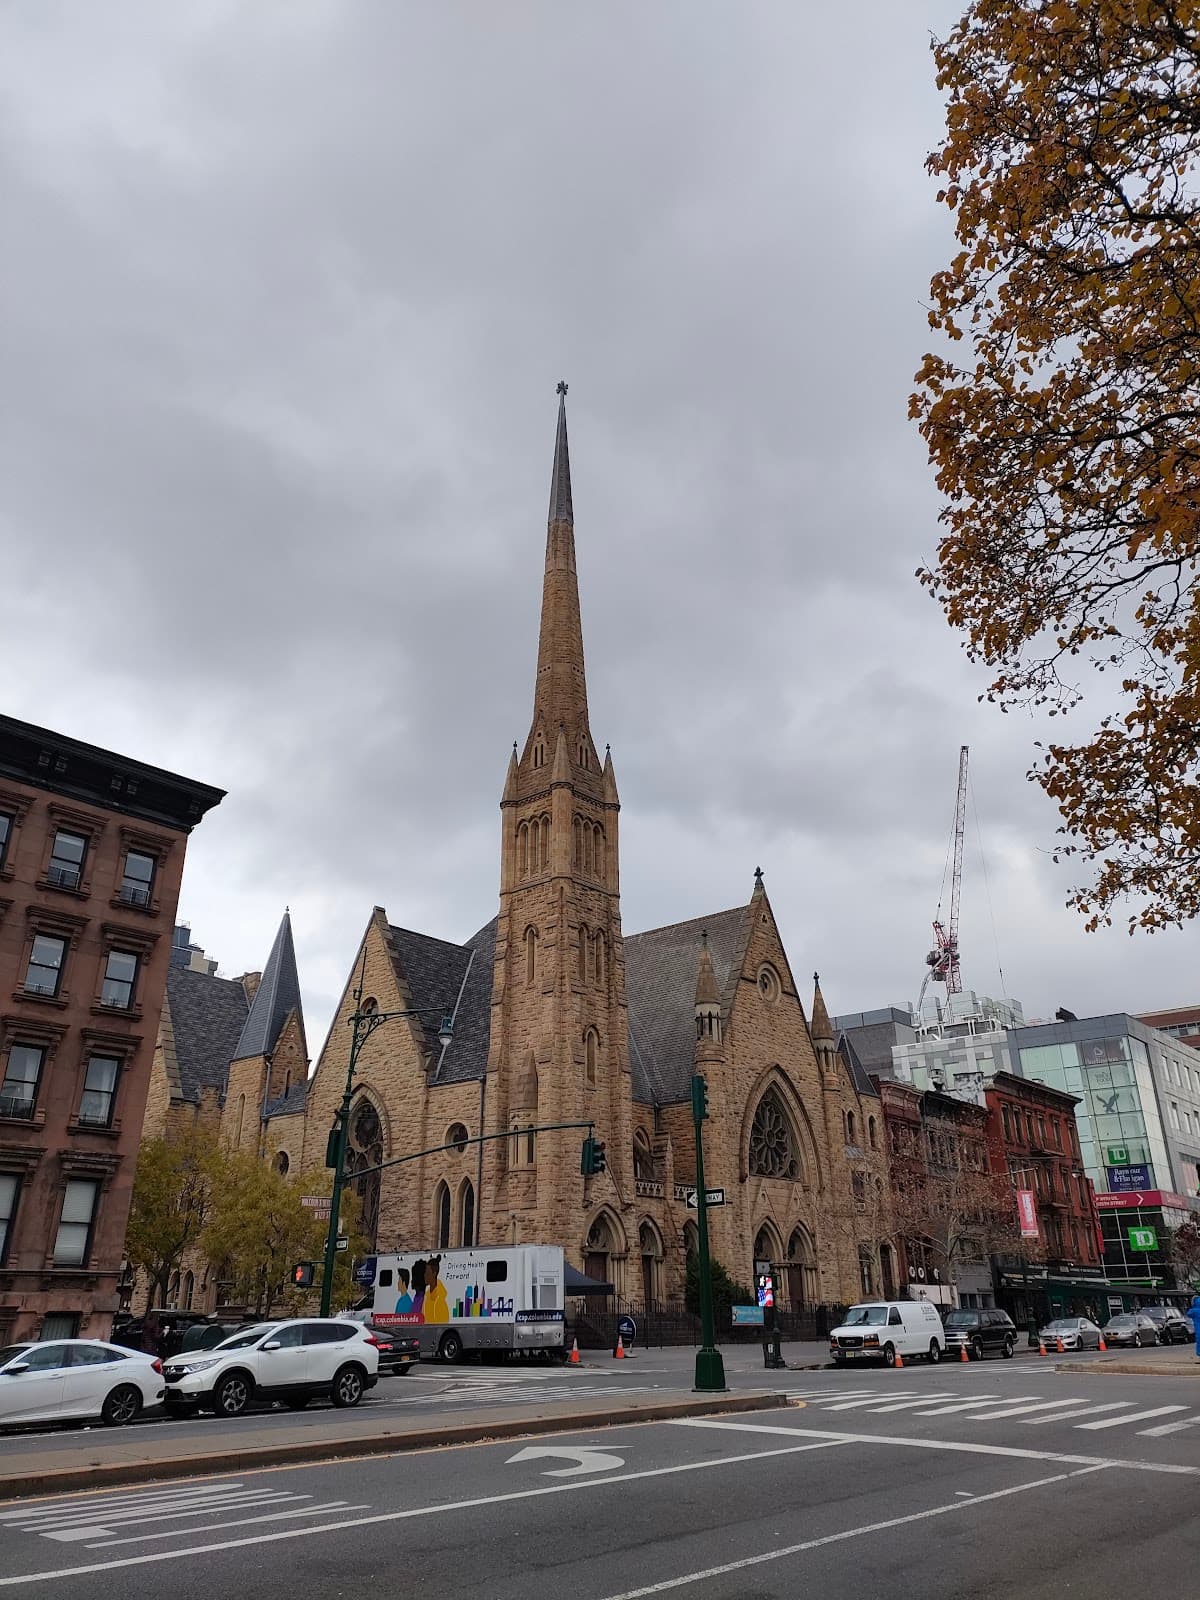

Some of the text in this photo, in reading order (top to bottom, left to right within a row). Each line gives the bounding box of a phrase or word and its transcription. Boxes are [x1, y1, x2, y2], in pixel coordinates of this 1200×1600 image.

[1110, 1148, 1127, 1160] TD
[1131, 1231, 1154, 1246] TD
[447, 1260, 485, 1271] Driving Health
[446, 1272, 470, 1281] Forward
